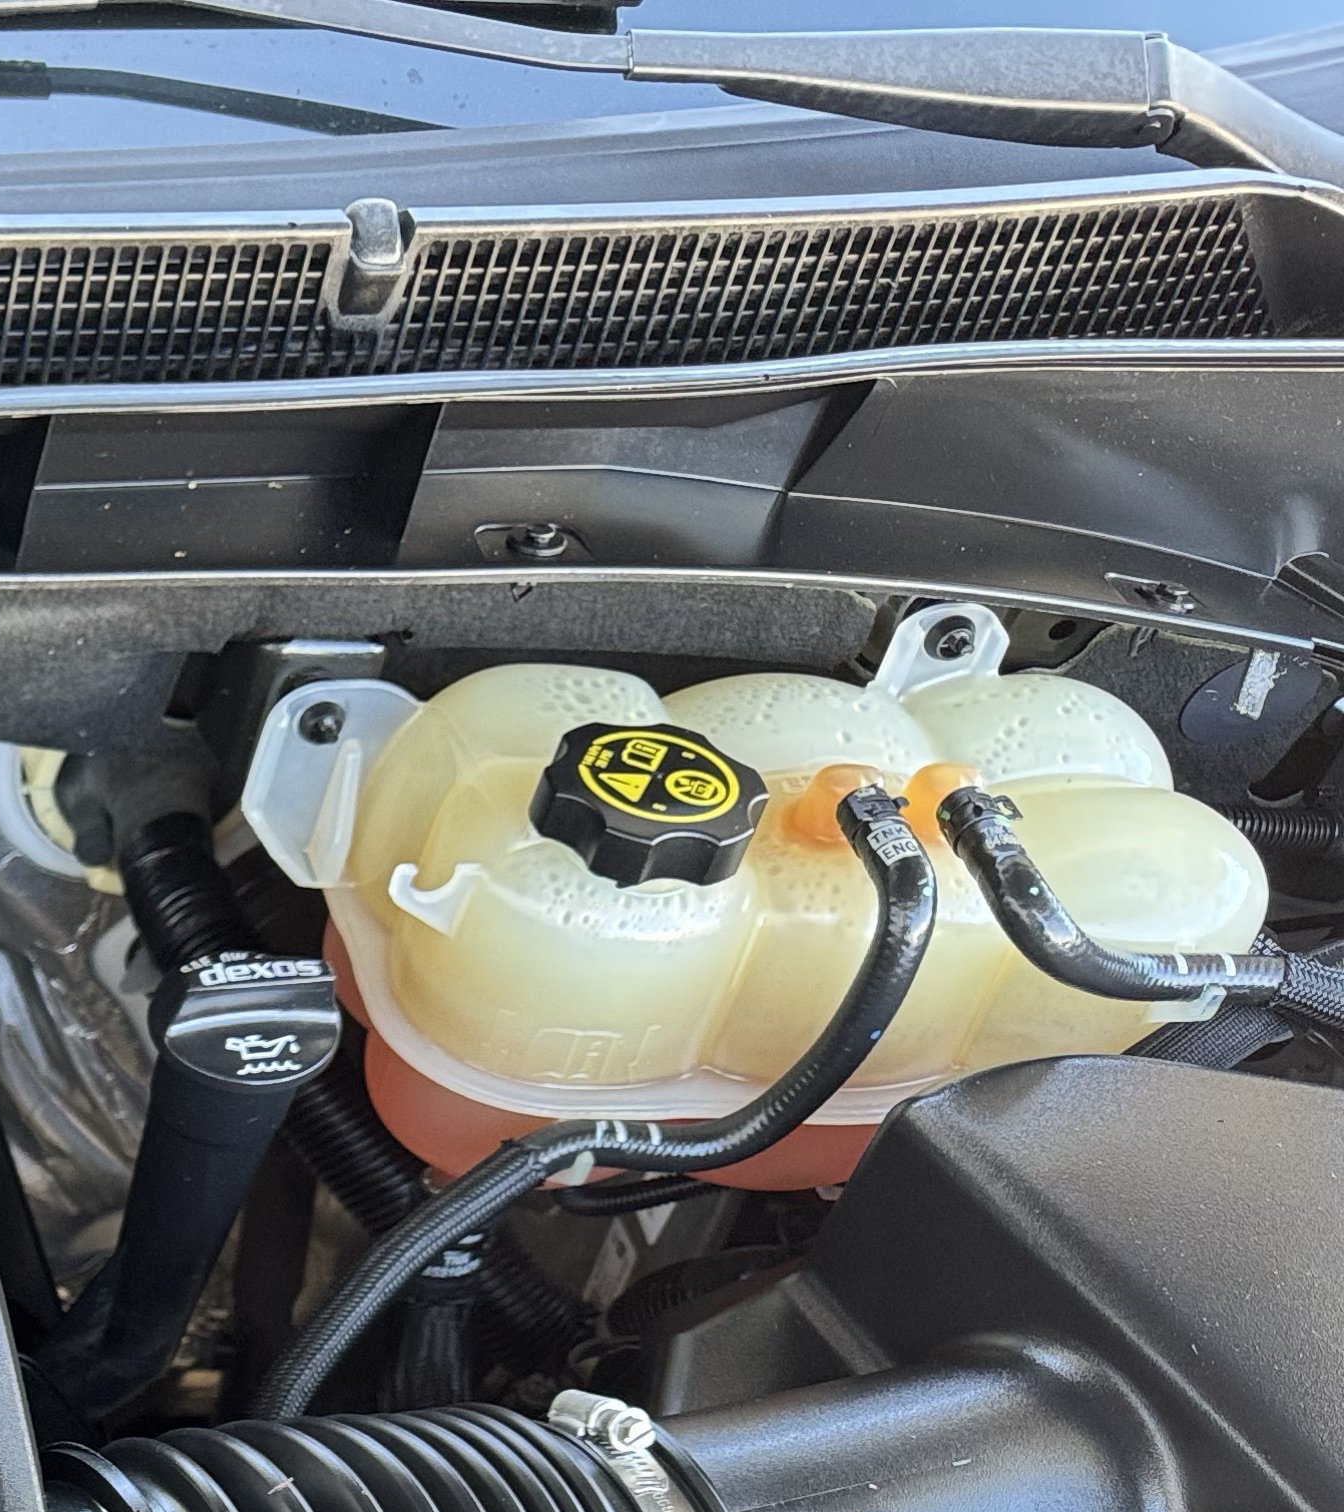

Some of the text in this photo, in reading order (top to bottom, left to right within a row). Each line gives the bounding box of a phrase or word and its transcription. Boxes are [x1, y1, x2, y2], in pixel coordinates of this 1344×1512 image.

[871, 825, 906, 843] TNK
[882, 841, 918, 860] ENG
[198, 959, 322, 986] dexos
